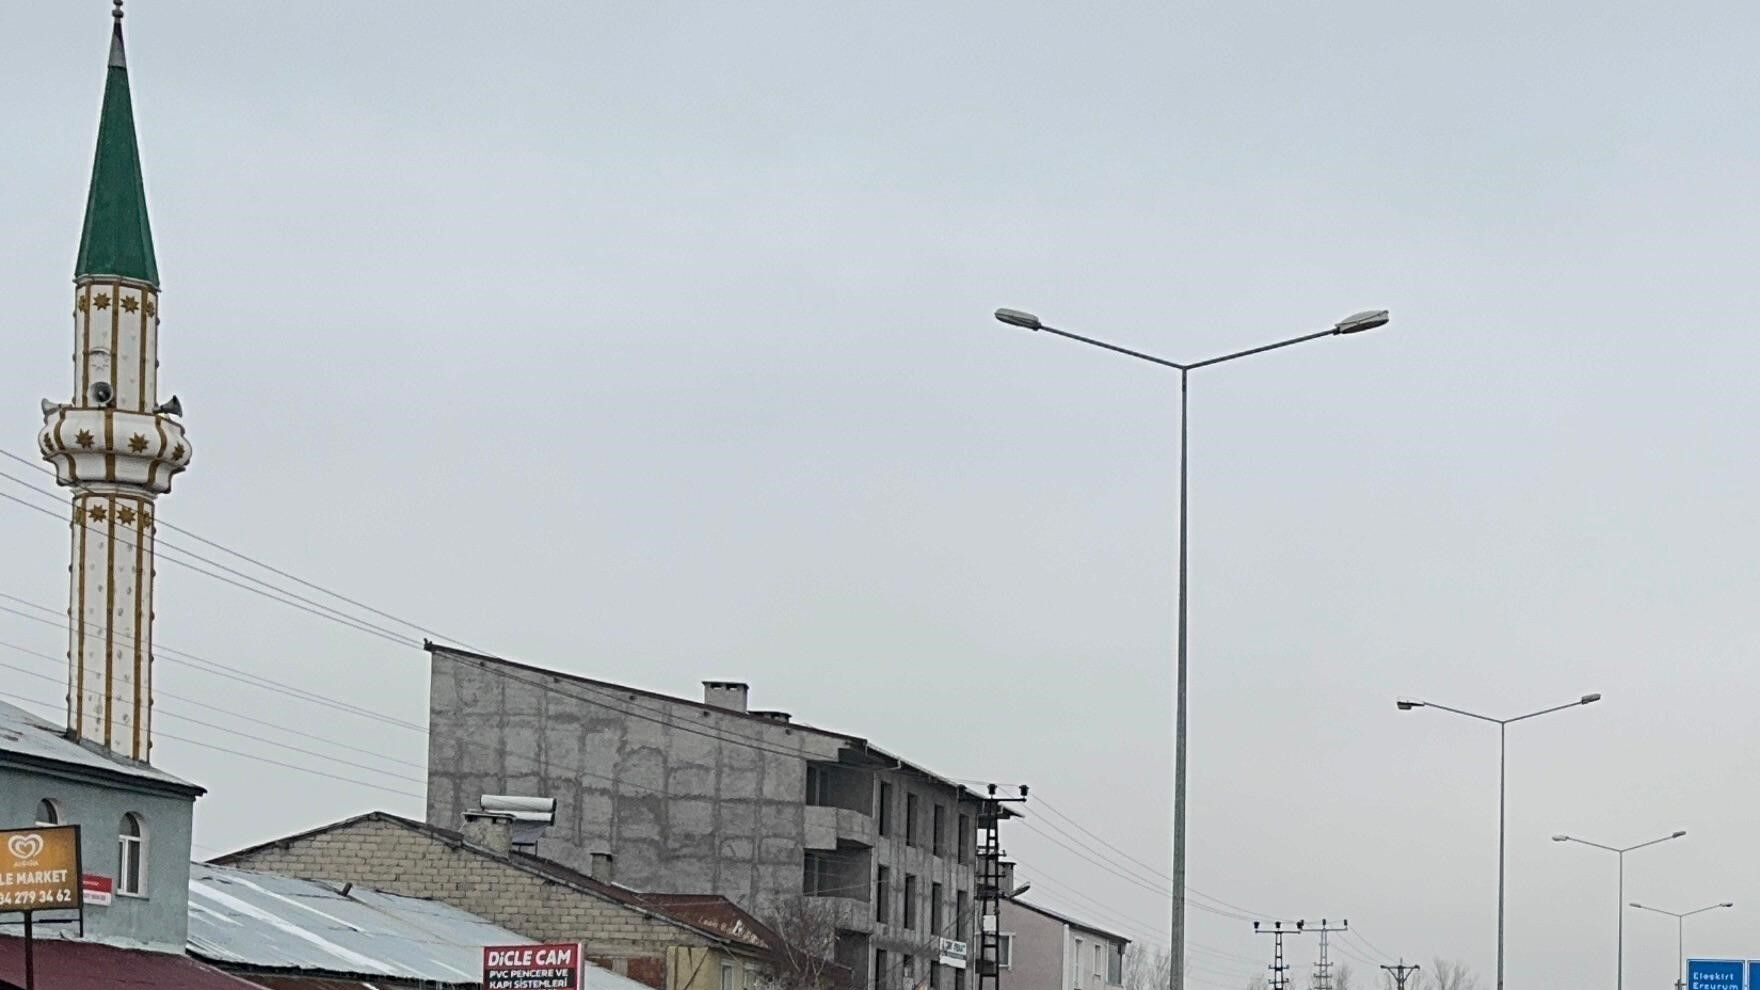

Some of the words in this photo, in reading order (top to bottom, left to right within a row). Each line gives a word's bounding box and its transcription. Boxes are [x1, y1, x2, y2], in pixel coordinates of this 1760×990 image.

[17, 870, 67, 883] MARKET
[15, 891, 36, 904] 279
[38, 889, 54, 904] 34
[57, 889, 71, 902] 62
[535, 949, 572, 966] CAM
[489, 970, 509, 979] PVC
[510, 969, 554, 978] PENCERE
[555, 968, 569, 977] VE
[489, 980, 513, 989] KAPI
[1692, 982, 1739, 990] Erzurum
